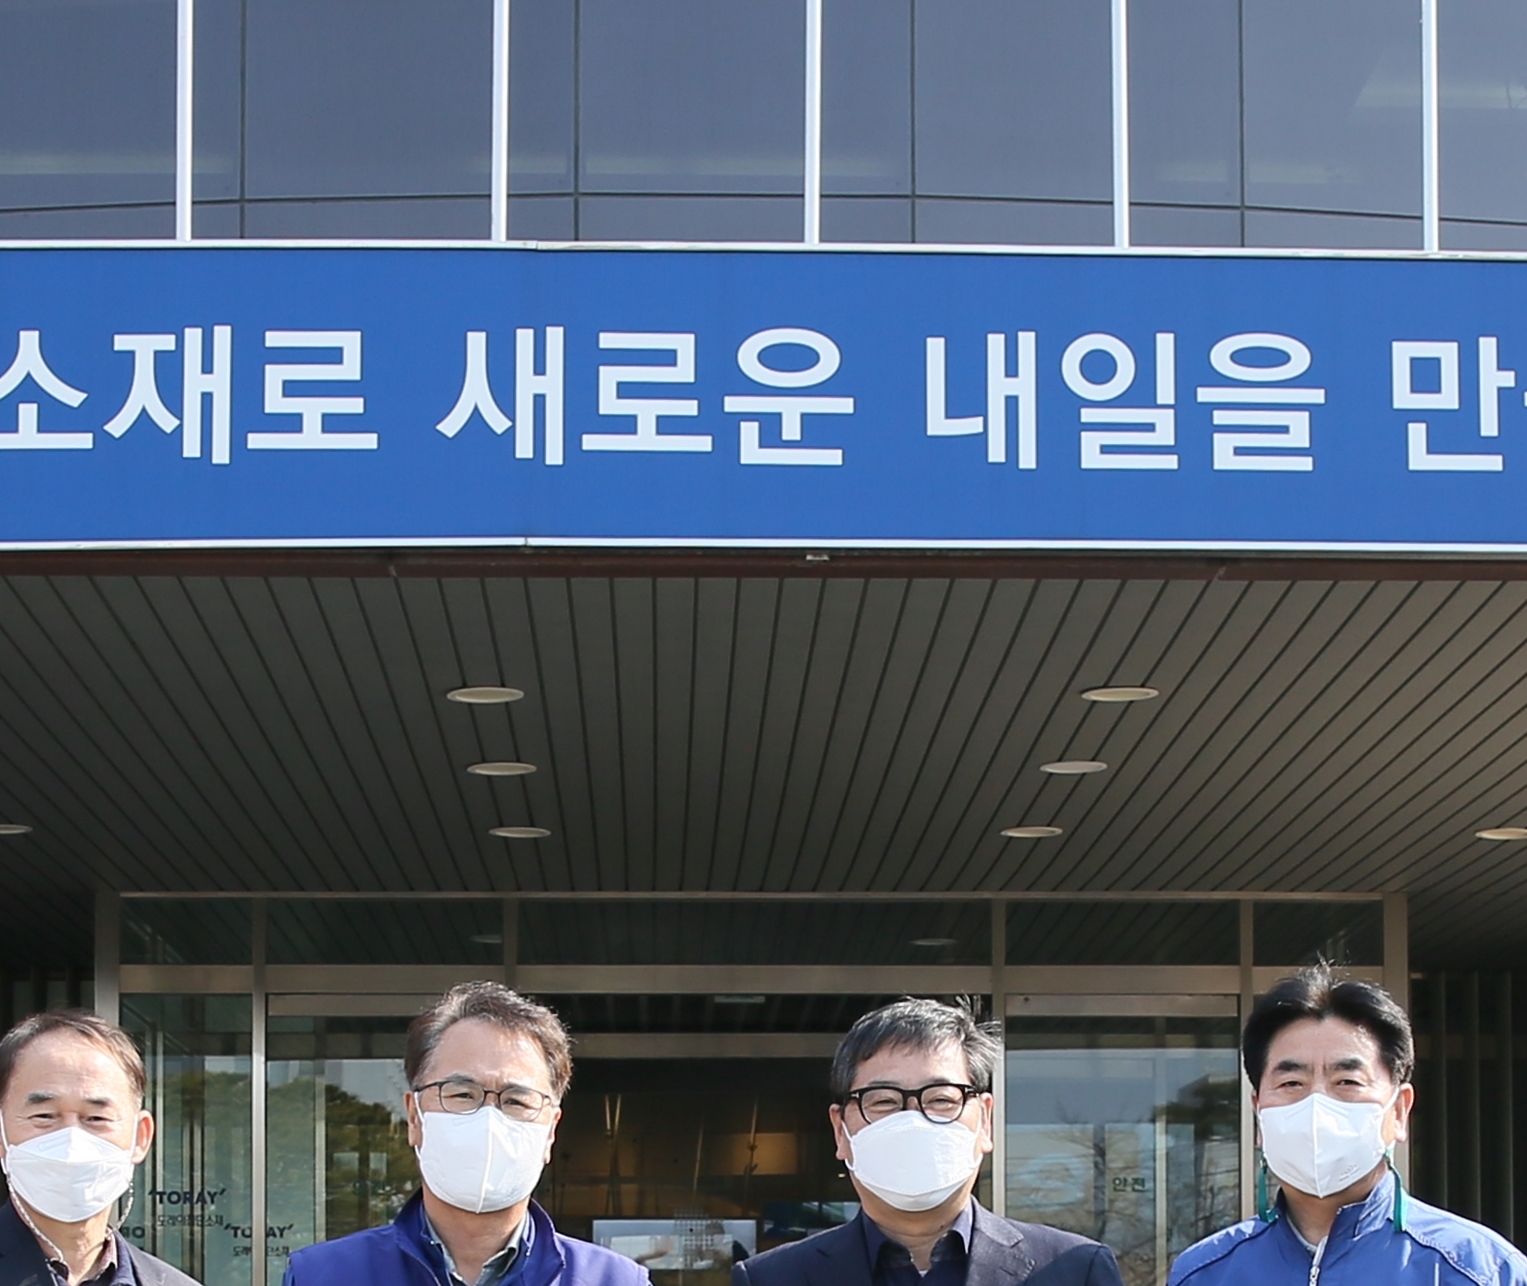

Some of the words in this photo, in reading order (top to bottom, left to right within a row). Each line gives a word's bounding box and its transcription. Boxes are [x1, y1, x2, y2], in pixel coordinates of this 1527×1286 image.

[435, 326, 855, 466] 새로운
[926, 331, 1326, 471] 내일을
[224, 1223, 294, 1239] TOAY
